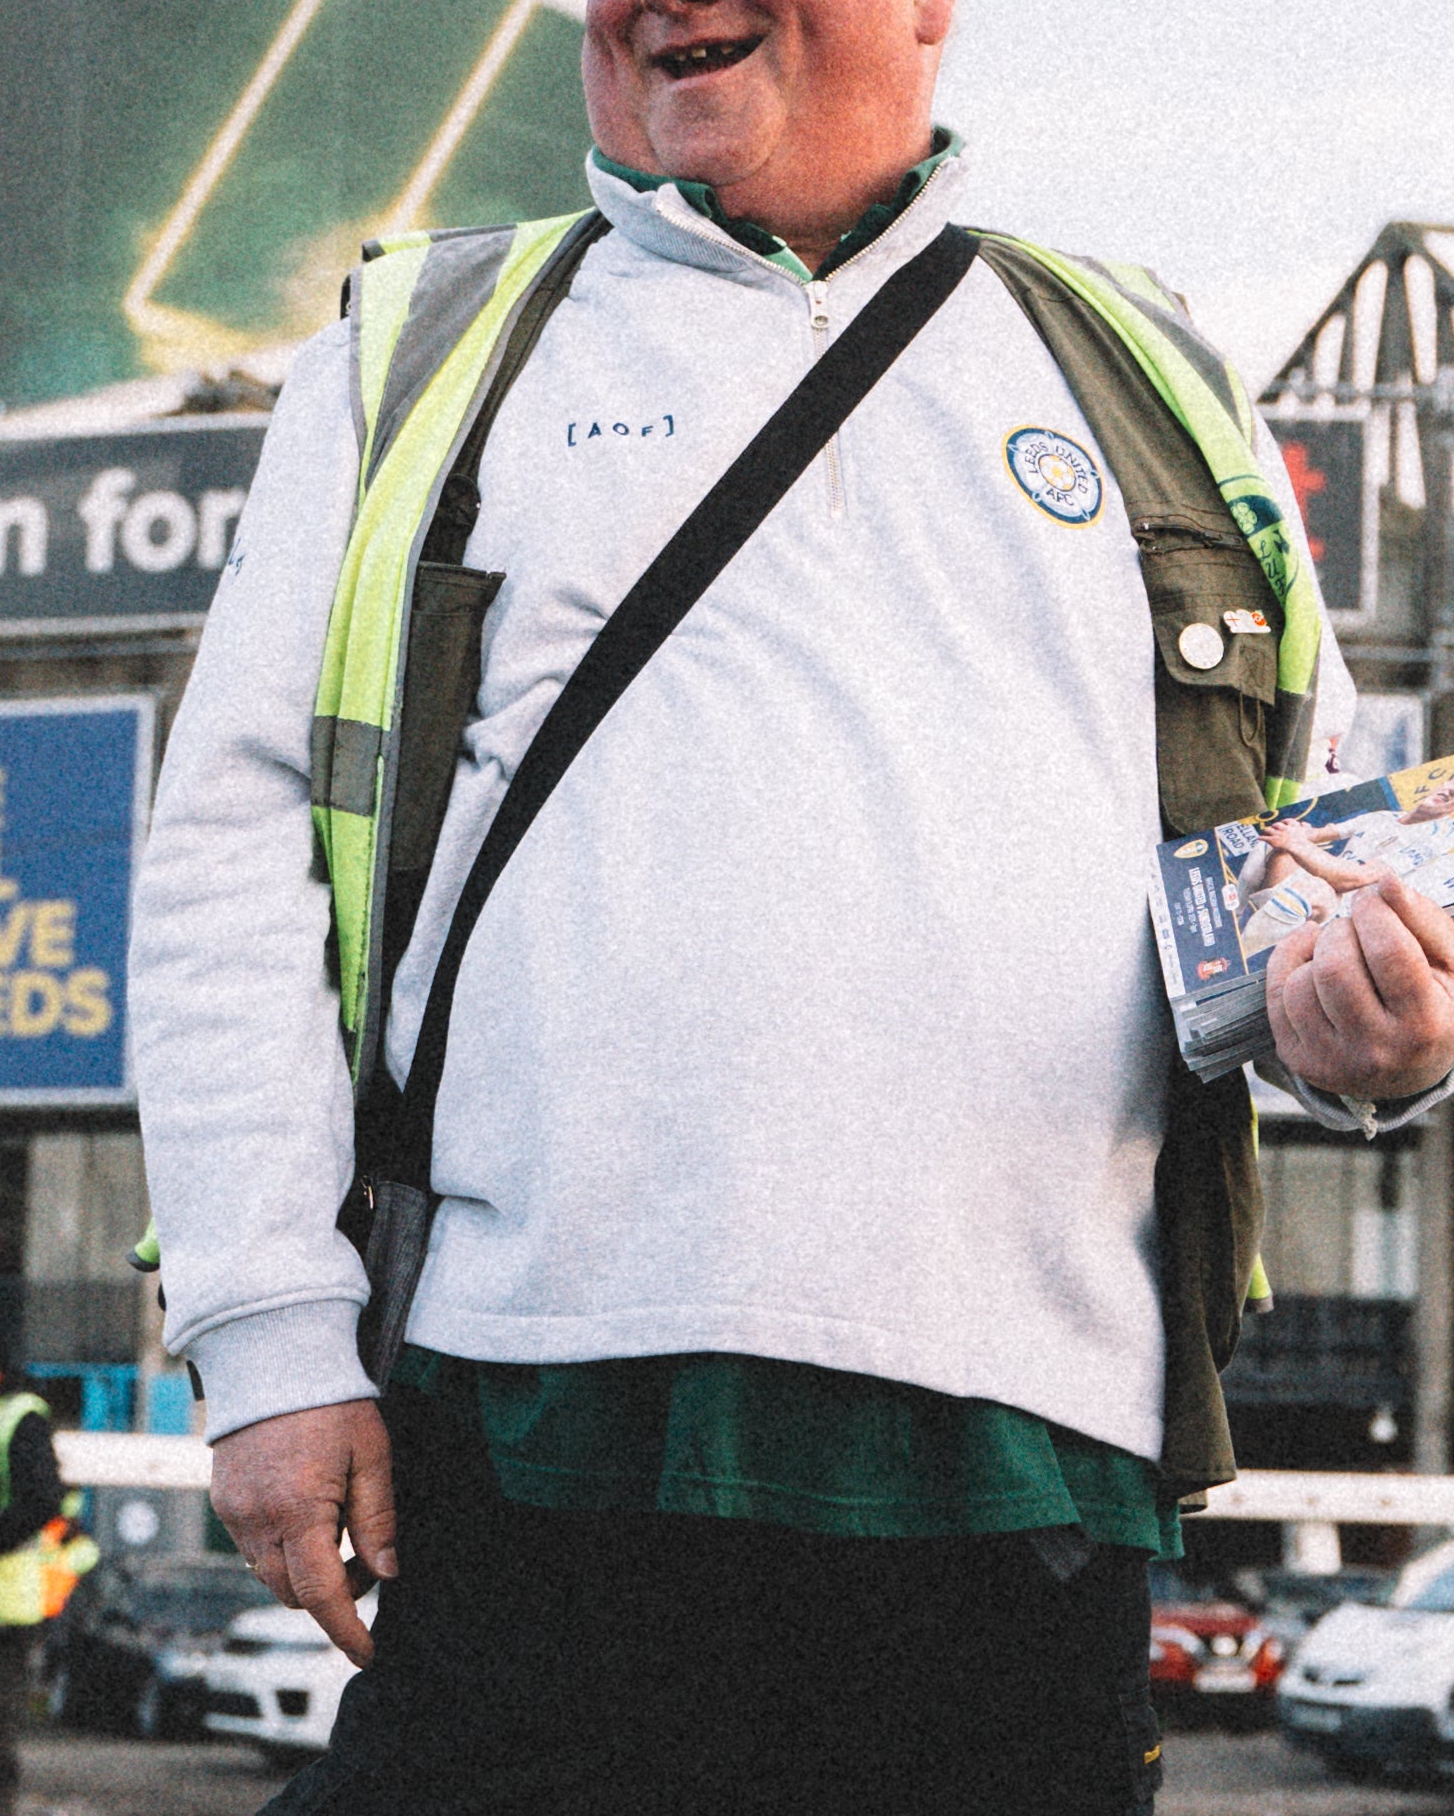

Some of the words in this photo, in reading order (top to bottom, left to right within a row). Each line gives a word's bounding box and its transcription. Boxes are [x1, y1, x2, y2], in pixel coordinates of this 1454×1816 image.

[1024, 441, 1049, 475] LEEDS
[1055, 445, 1089, 494] UNITED
[78, 468, 248, 574] for
[1046, 488, 1074, 506] AFC
